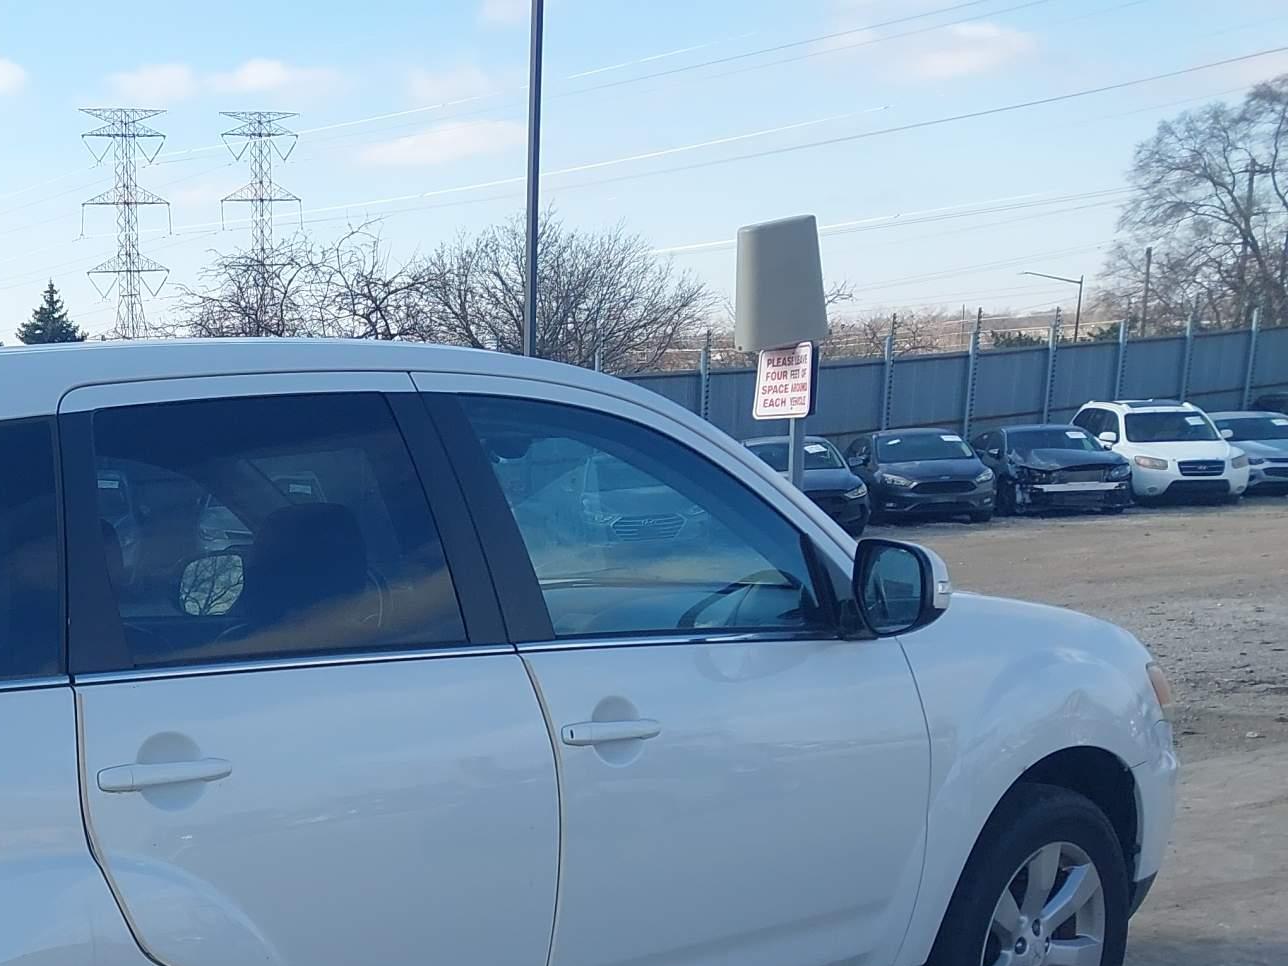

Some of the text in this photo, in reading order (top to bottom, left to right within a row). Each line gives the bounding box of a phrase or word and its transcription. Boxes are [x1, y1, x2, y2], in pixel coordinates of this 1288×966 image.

[767, 356, 793, 368] PLEASE
[766, 370, 788, 381] FOUR
[761, 384, 790, 395] SPACE
[763, 398, 787, 408] EACH
